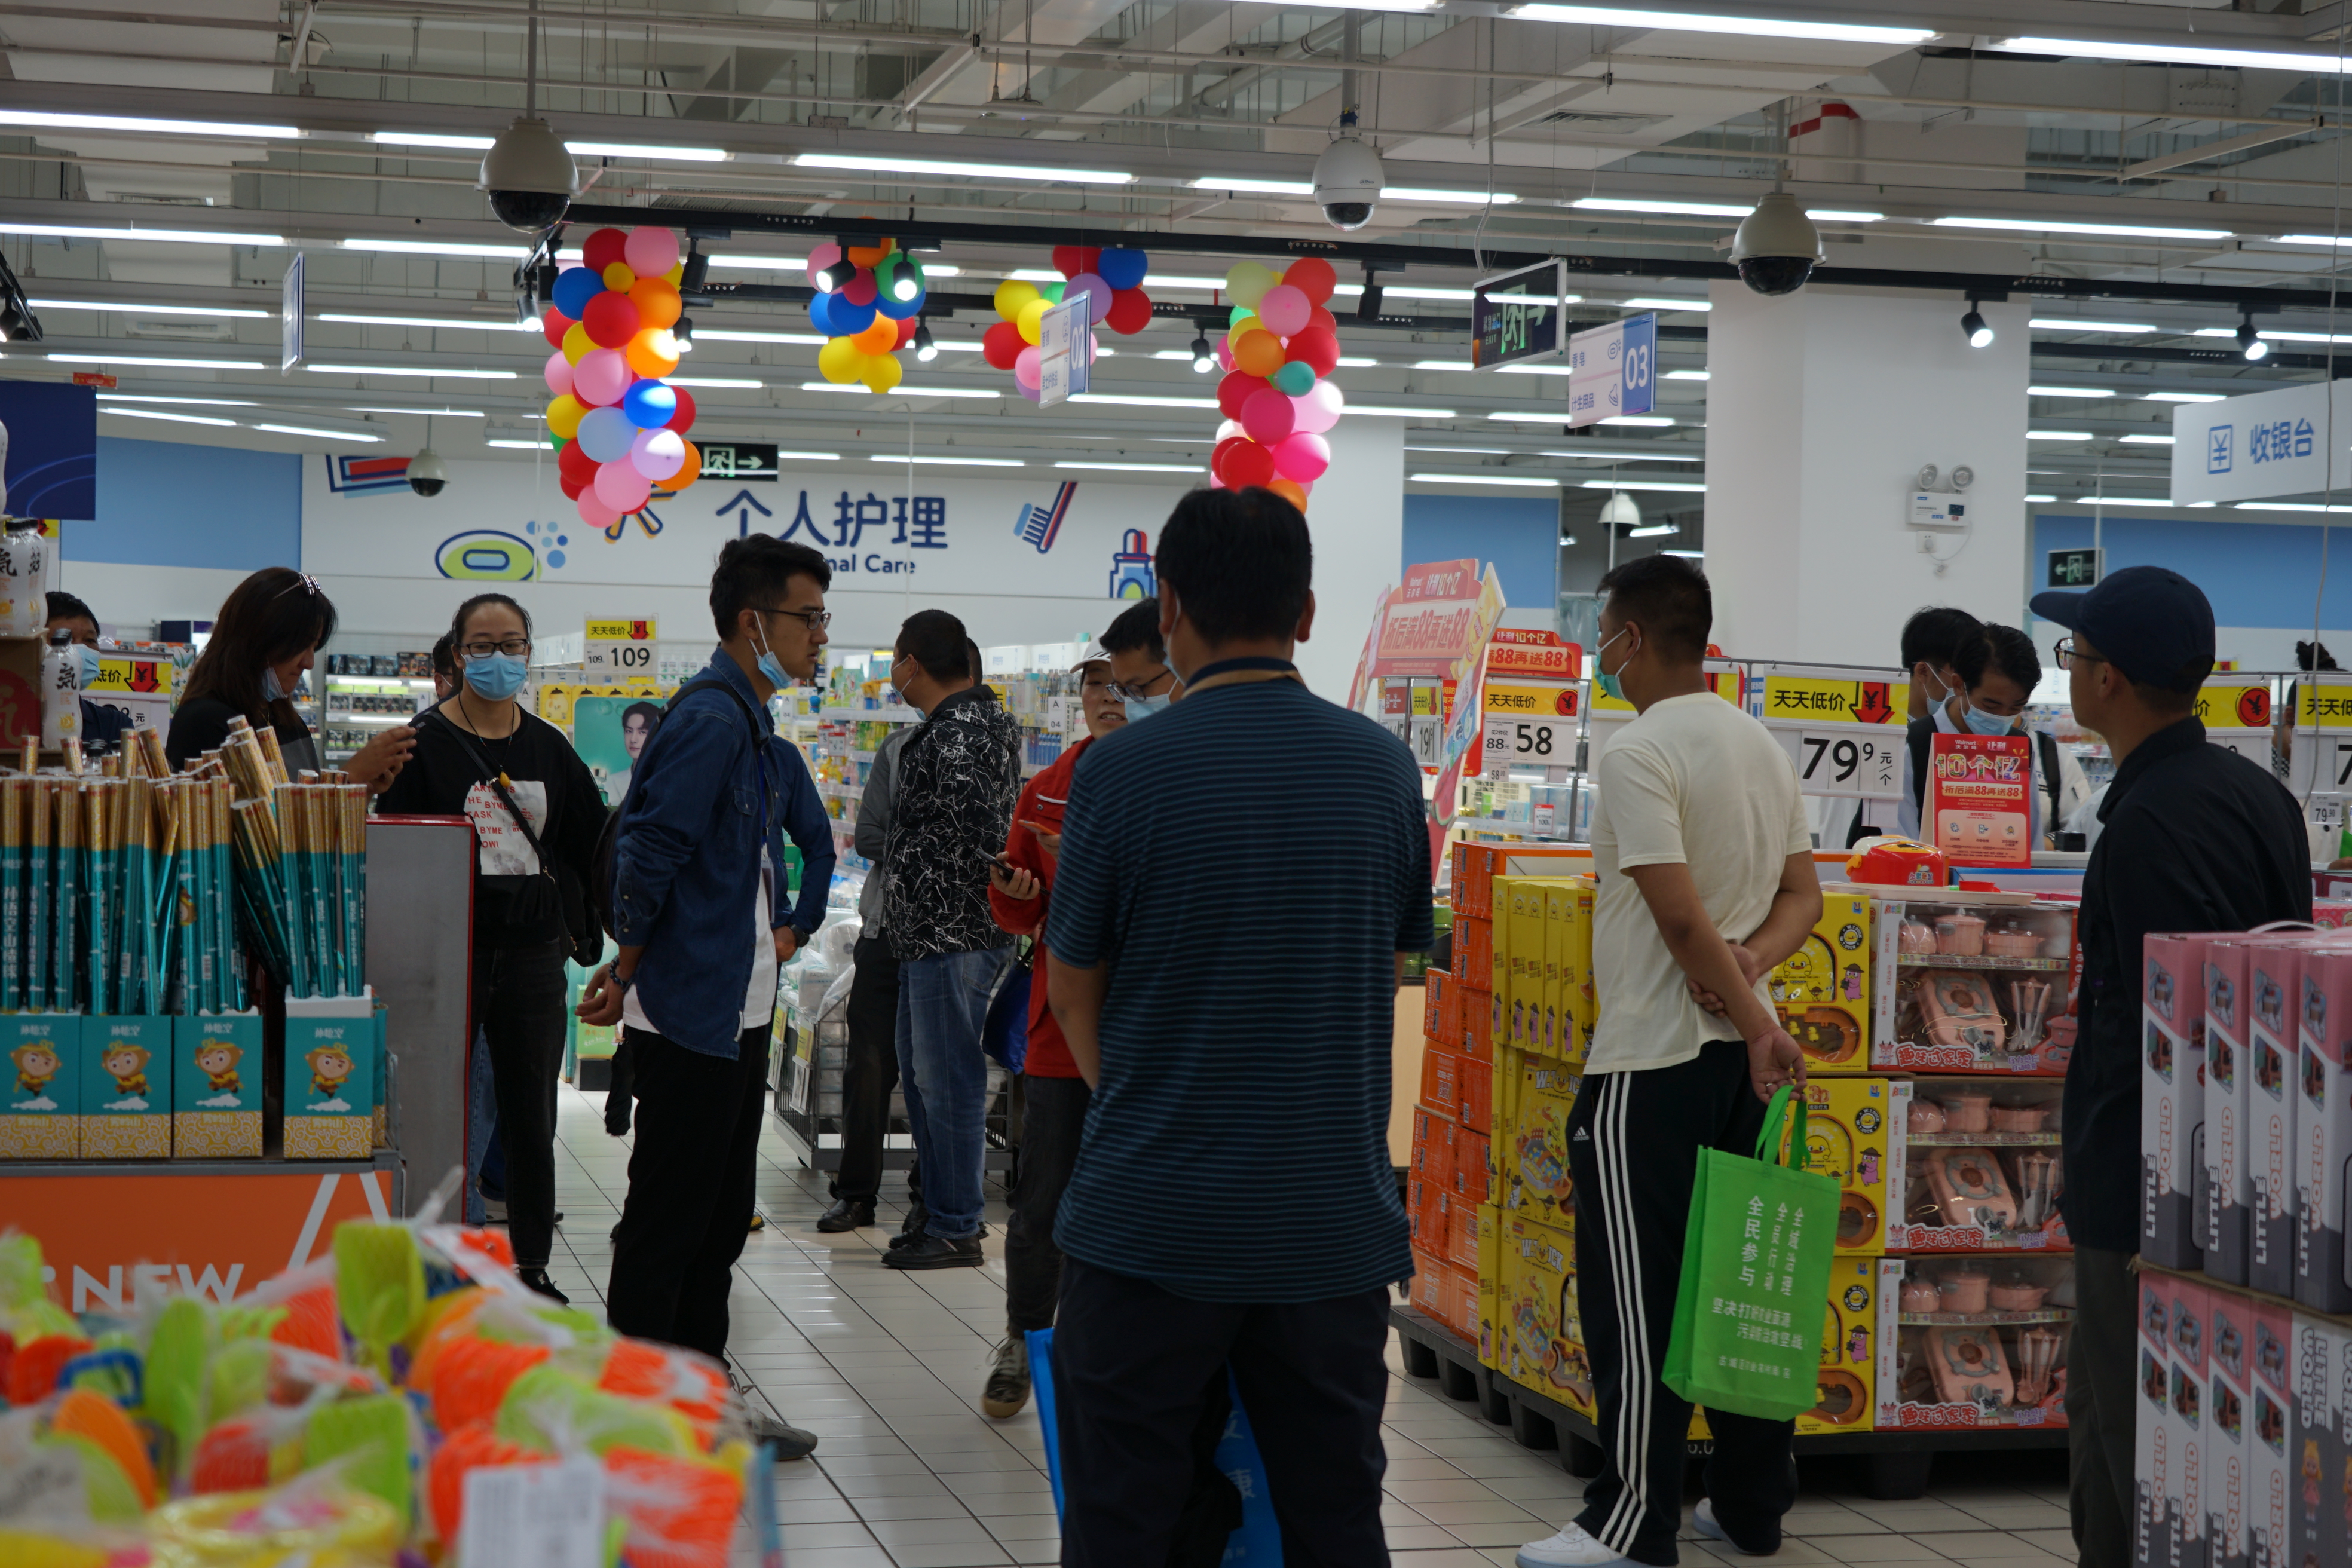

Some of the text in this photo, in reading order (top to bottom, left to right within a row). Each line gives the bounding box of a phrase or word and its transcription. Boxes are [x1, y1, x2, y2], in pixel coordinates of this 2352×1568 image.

[1071, 324, 1085, 370] 02
[1485, 334, 1497, 345] EXIT
[1625, 345, 1648, 390] 03
[1572, 393, 1595, 412] 计生用品
[2250, 418, 2314, 465] 收银台
[716, 489, 948, 549] 个人护理
[864, 554, 915, 574] Care
[590, 626, 626, 635] 天天低价
[611, 647, 650, 667] 109
[1488, 694, 1536, 709] 天天低价
[1774, 689, 1846, 712] 天天低价
[1515, 724, 1552, 755] 58
[1987, 741, 2006, 751] 让利
[1935, 753, 2020, 782] 10个亿
[1944, 785, 2019, 797] 折后满88再送88
[2315, 808, 2335, 823] 79.90
[1897, 1045, 1972, 1068] 趣味过家家
[2146, 1097, 2172, 1238] LITTLE WORLD
[2209, 1107, 2233, 1252] LITTLE WORLD
[2255, 1114, 2283, 1266] LITTLE WORLD
[2299, 1124, 2323, 1277] LITTLE WORLD
[1738, 1195, 1765, 1287] 全民参与
[1908, 1226, 1983, 1250] 趣味过家家
[73, 1263, 245, 1313] NEW
[2301, 1327, 2328, 1429] WORLD LITTLE
[1900, 1403, 1978, 1427] 趣味过家家
[2139, 1426, 2166, 1563] LITTLE WORLD
[2184, 1441, 2198, 1542] WORLD
[2226, 1456, 2240, 1559] WORLD
